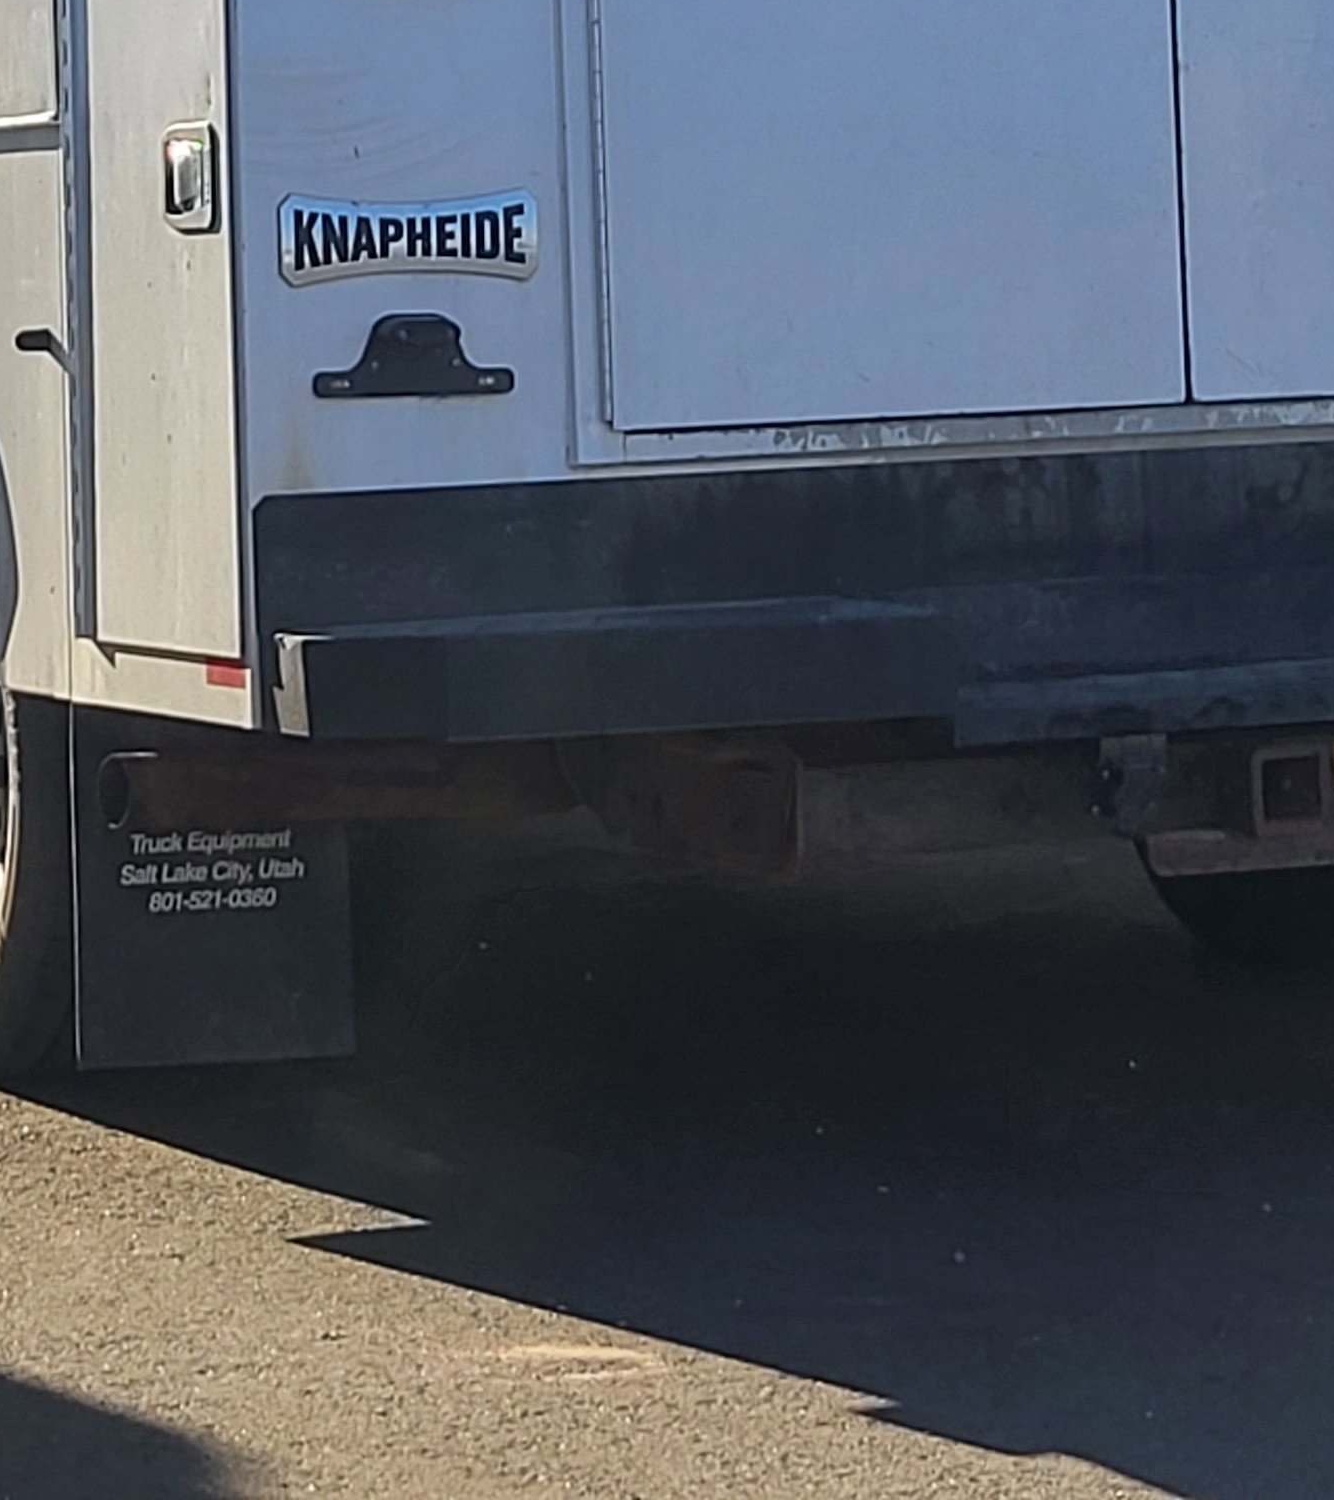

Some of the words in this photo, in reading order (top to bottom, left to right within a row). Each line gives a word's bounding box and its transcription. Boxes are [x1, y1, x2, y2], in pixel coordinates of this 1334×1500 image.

[293, 203, 526, 271] KNAPHEIDE
[130, 831, 183, 855] Truck
[187, 829, 291, 855] Equipment
[120, 864, 157, 886] Salt
[161, 862, 207, 883] Lake
[212, 859, 254, 884] City,
[259, 856, 304, 880] Utah
